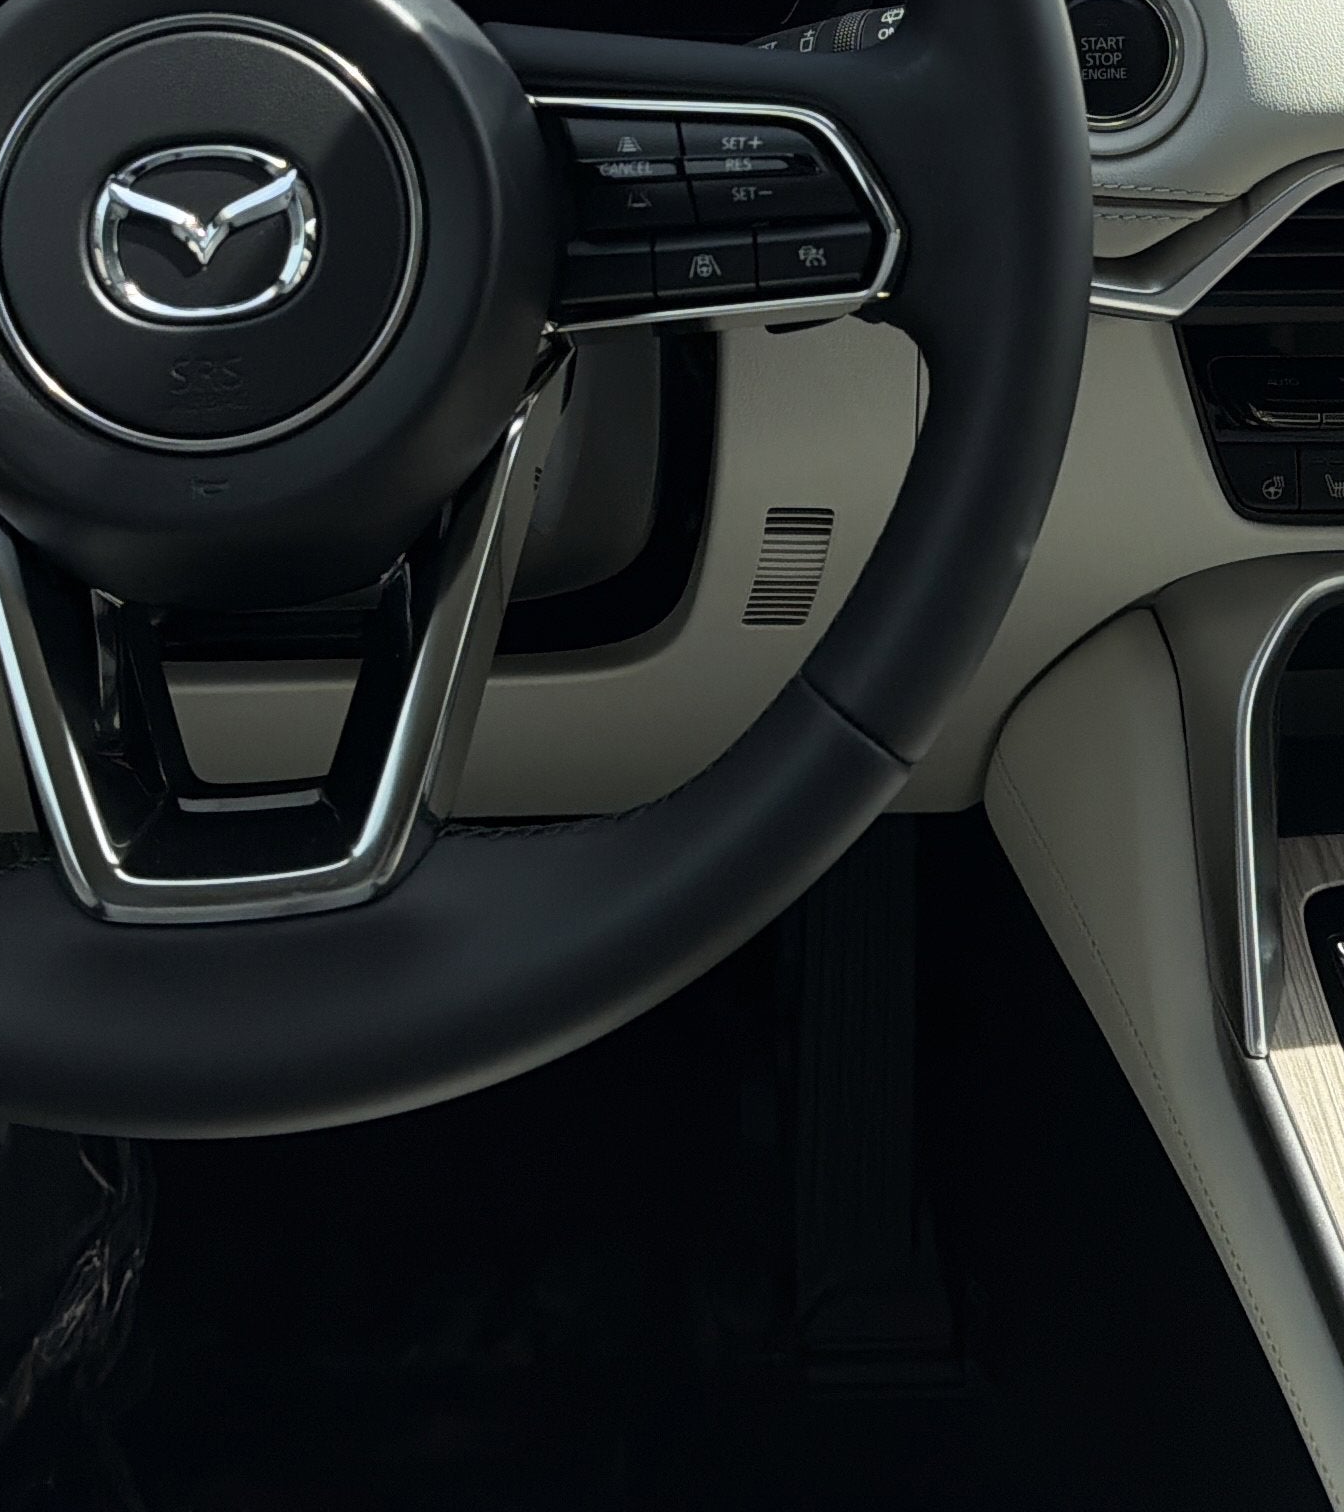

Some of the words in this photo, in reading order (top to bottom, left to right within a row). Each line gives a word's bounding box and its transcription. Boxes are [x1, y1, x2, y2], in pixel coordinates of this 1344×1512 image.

[1081, 37, 1124, 50] START
[1086, 52, 1121, 66] STOP
[1083, 68, 1127, 80] ENGINE
[599, 161, 653, 176] CANCEL
[724, 159, 752, 171] RES
